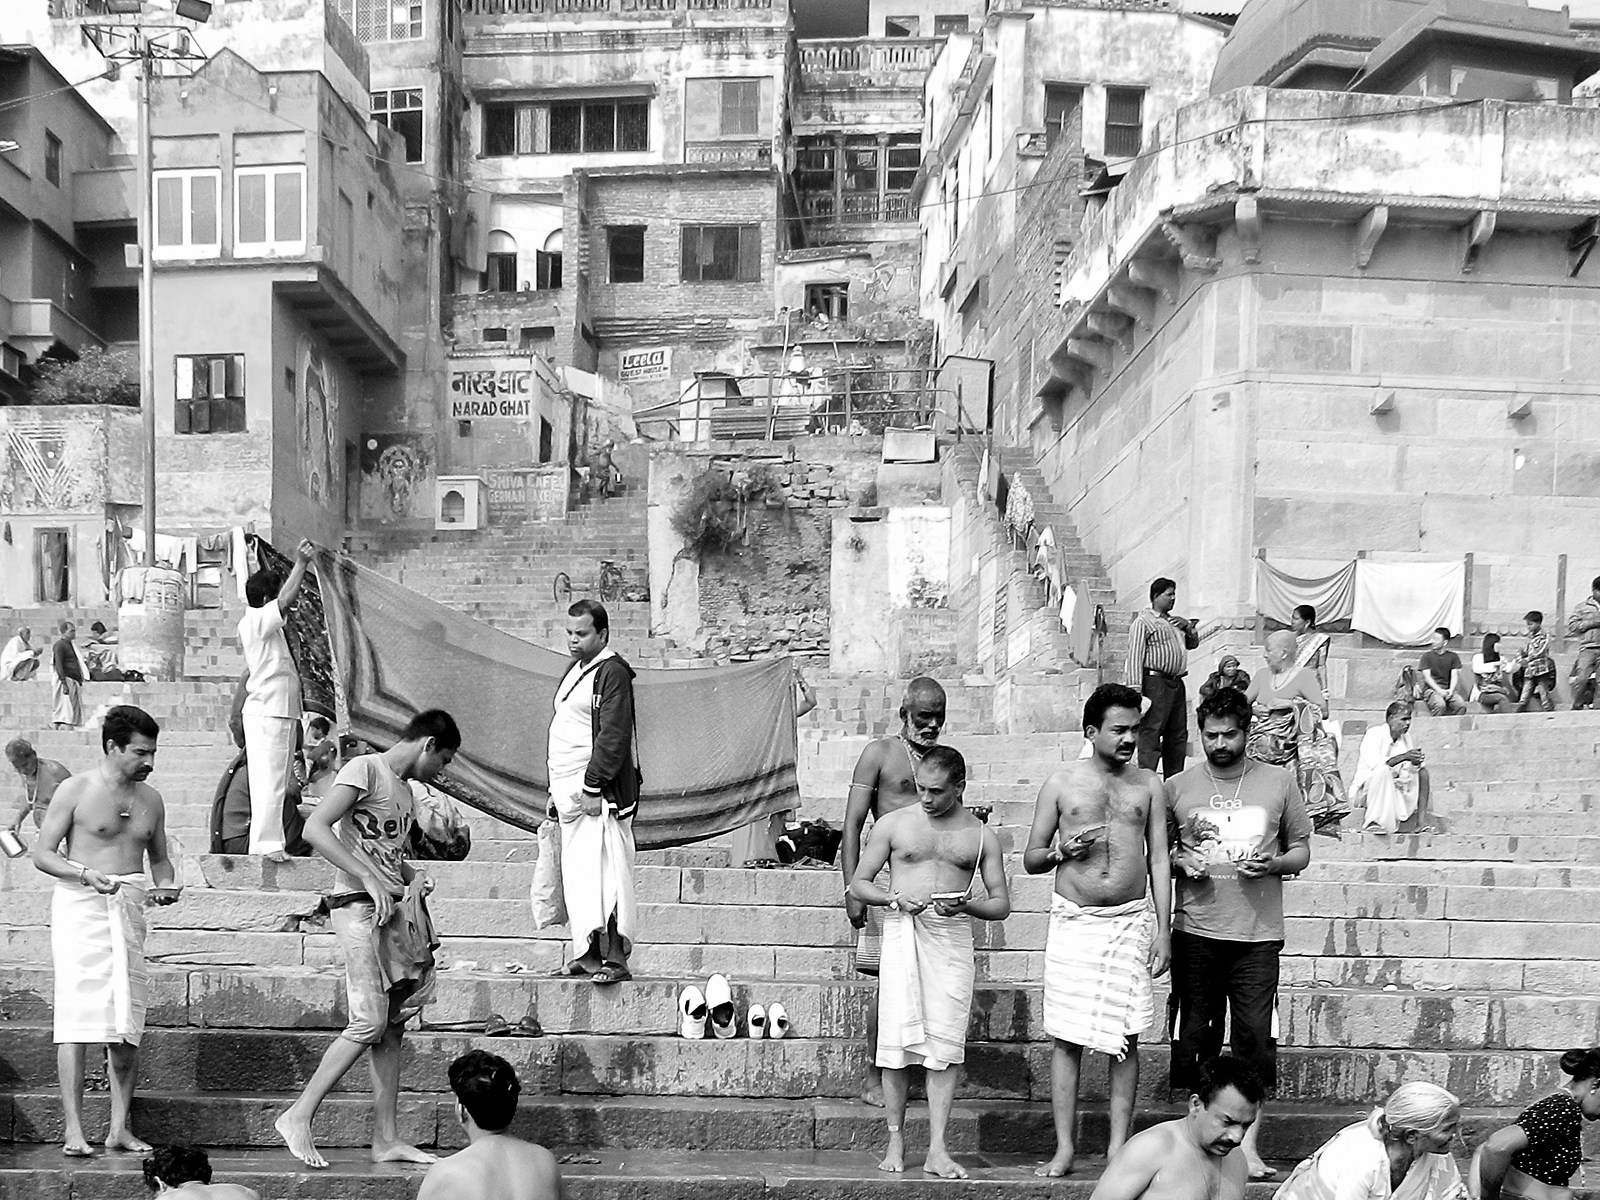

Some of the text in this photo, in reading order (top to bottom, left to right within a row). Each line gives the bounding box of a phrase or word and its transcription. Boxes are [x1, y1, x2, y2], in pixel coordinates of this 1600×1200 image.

[624, 352, 663, 368] Leela
[452, 400, 531, 417] NARAD GHAT
[489, 474, 525, 489] SHIVA
[1209, 794, 1243, 810] Goa
